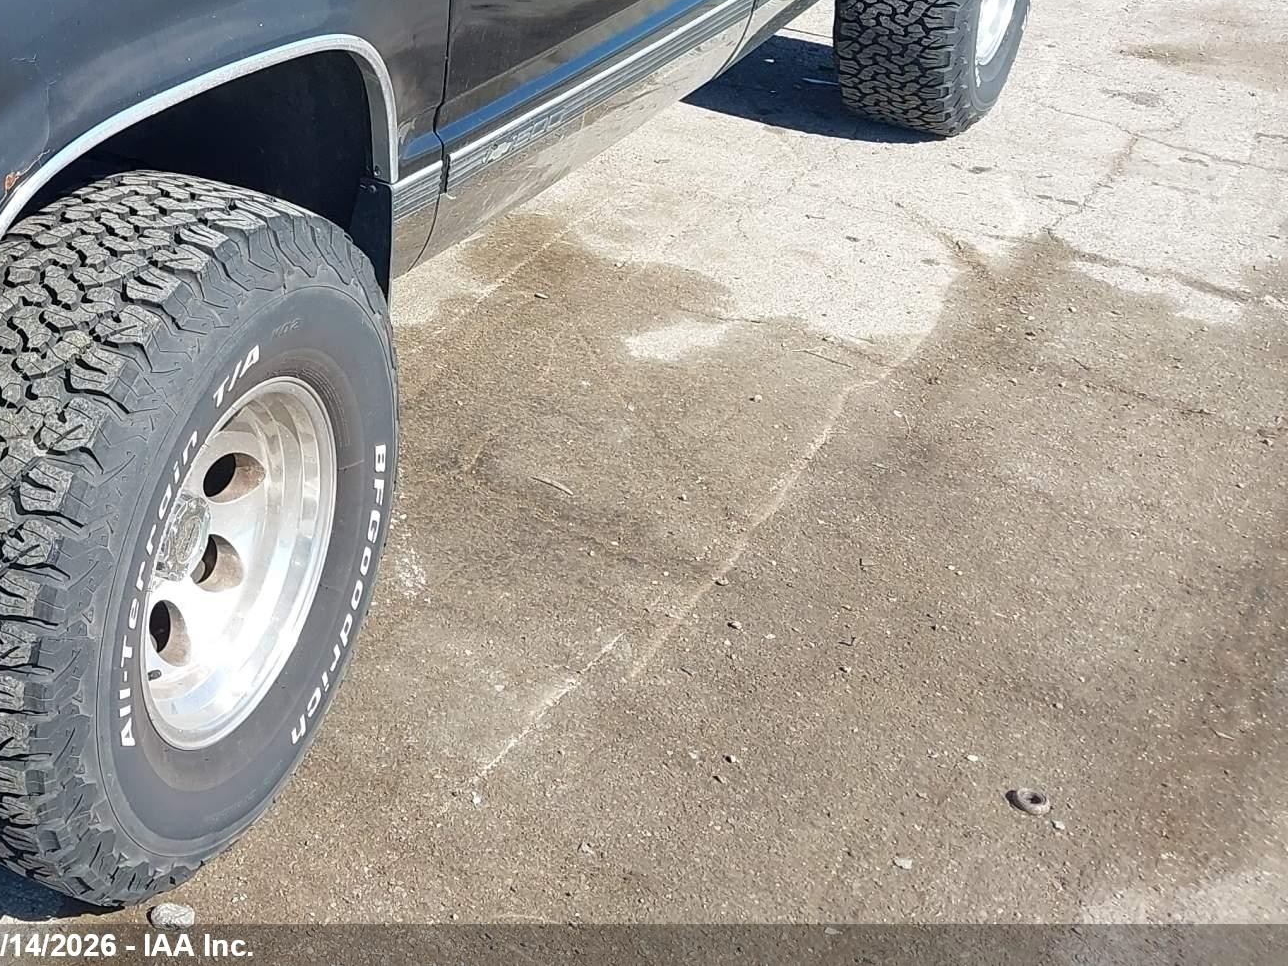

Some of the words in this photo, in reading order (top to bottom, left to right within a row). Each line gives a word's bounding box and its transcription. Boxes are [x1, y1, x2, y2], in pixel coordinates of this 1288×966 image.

[119, 430, 199, 747] All-Terrain
[212, 344, 261, 408] T/A
[291, 444, 388, 745] BFGoodrich
